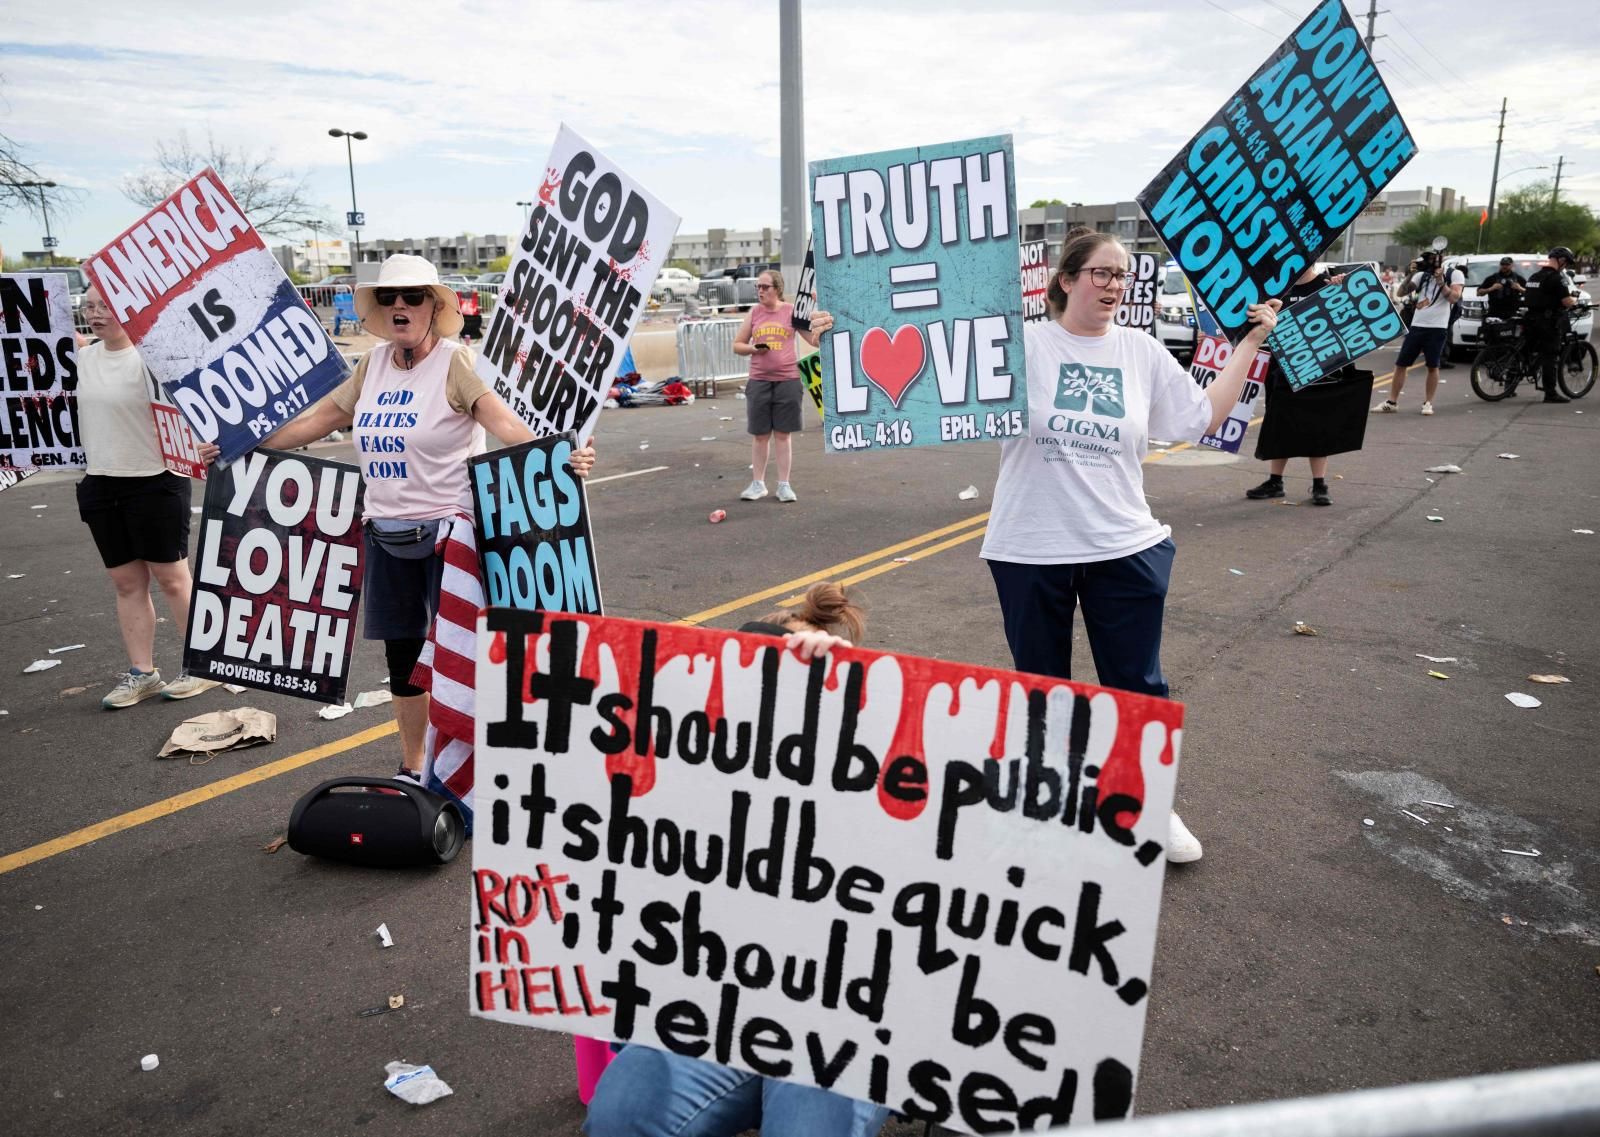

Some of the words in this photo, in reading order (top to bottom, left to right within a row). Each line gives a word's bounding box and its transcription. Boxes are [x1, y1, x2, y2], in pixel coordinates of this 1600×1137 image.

[1297, 0, 1390, 136] DON'T
[1358, 112, 1417, 188] BE
[1249, 52, 1368, 228] ASHAMED
[559, 151, 649, 264] GOD
[813, 150, 1009, 258] TRUTH
[1188, 126, 1305, 293] CHRIST'S
[1231, 106, 1253, 137] Pet.
[1246, 130, 1270, 163] 4:16
[1261, 158, 1297, 202] OF
[1300, 220, 1323, 252] 8:38
[91, 176, 250, 323] AMERICA
[521, 206, 590, 290] SENT
[588, 257, 642, 339] THE
[1020, 242, 1044, 266] NOT
[1021, 266, 1048, 292] ORMED
[1150, 170, 1259, 328] WORD
[187, 288, 237, 343] IS
[503, 259, 614, 392] SHOOTER
[1023, 293, 1046, 317] THIS
[1116, 304, 1154, 326] OUD
[1124, 281, 1154, 304] TES
[1318, 284, 1359, 325] DOES
[1339, 318, 1377, 356] NOT
[1347, 270, 1401, 340] GOD
[0, 337, 78, 392] EDS
[1273, 309, 1324, 386] EVERYONE
[1296, 305, 1342, 362] LOVE
[173, 305, 329, 443] DOOMED
[377, 390, 414, 406] GOD
[484, 307, 524, 378] IN
[517, 346, 598, 434] FURY
[494, 377, 512, 404] ISA
[154, 408, 200, 465] ENE
[247, 410, 278, 440] PS.
[277, 385, 311, 418] 9:17
[357, 412, 418, 428] HATES
[360, 436, 406, 453] FAGS
[831, 425, 871, 450] GAL.
[874, 420, 913, 446] 4:16
[940, 416, 980, 441] EPH.
[984, 410, 1023, 436] 4:15
[1035, 436, 1067, 447] CIGNA
[1070, 439, 1122, 457] HealthCare
[1047, 414, 1120, 442] CIGNA
[31, 452, 67, 466] GEN.
[227, 452, 360, 536] YOU
[365, 461, 408, 479] .COM
[474, 440, 581, 540] FAGS
[200, 519, 358, 611] LOVE
[485, 536, 598, 612] DOOM
[190, 590, 350, 677] DEATH
[209, 660, 271, 685] PROVERBS
[273, 672, 317, 694] 8:35-36
[487, 609, 596, 753] It
[590, 628, 826, 786] should
[832, 661, 928, 802] be
[936, 688, 1163, 867] public,
[491, 762, 556, 848] it
[561, 774, 789, 899] should
[792, 801, 885, 914] be
[892, 866, 1147, 1006] quick,
[478, 925, 530, 965] in
[561, 871, 624, 954] it
[631, 890, 893, 1022] should
[953, 955, 1056, 1070] be
[476, 965, 611, 1017] HELL
